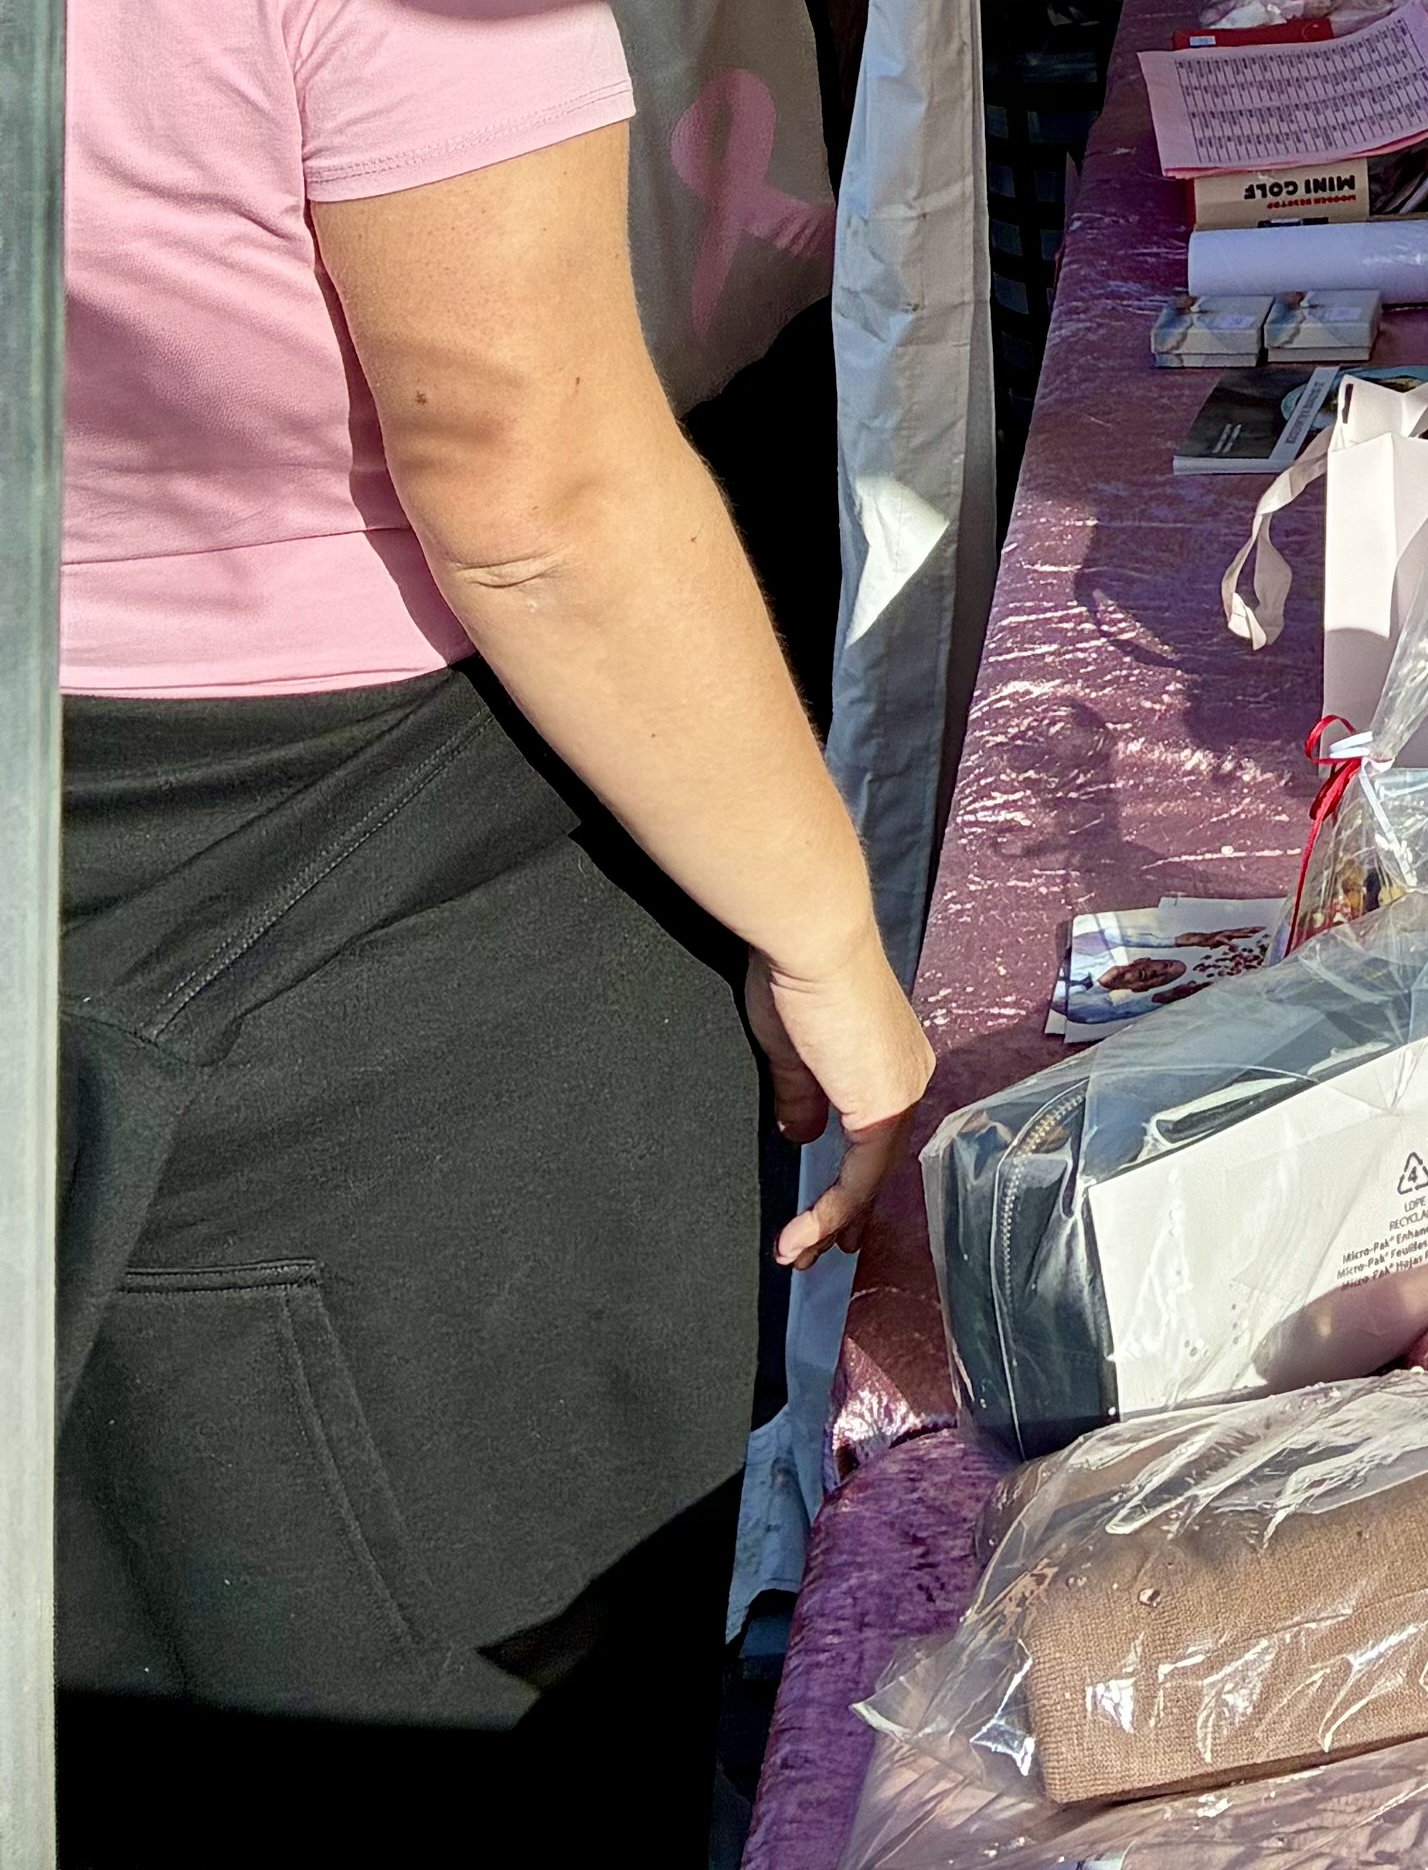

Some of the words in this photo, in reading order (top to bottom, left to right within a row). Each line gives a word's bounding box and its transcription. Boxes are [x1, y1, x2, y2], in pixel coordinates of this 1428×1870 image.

[1243, 181, 1299, 200] GOLF
[1304, 175, 1355, 195] MINI
[1408, 1166, 1418, 1183] 4
[1404, 1196, 1426, 1212] LDPE
